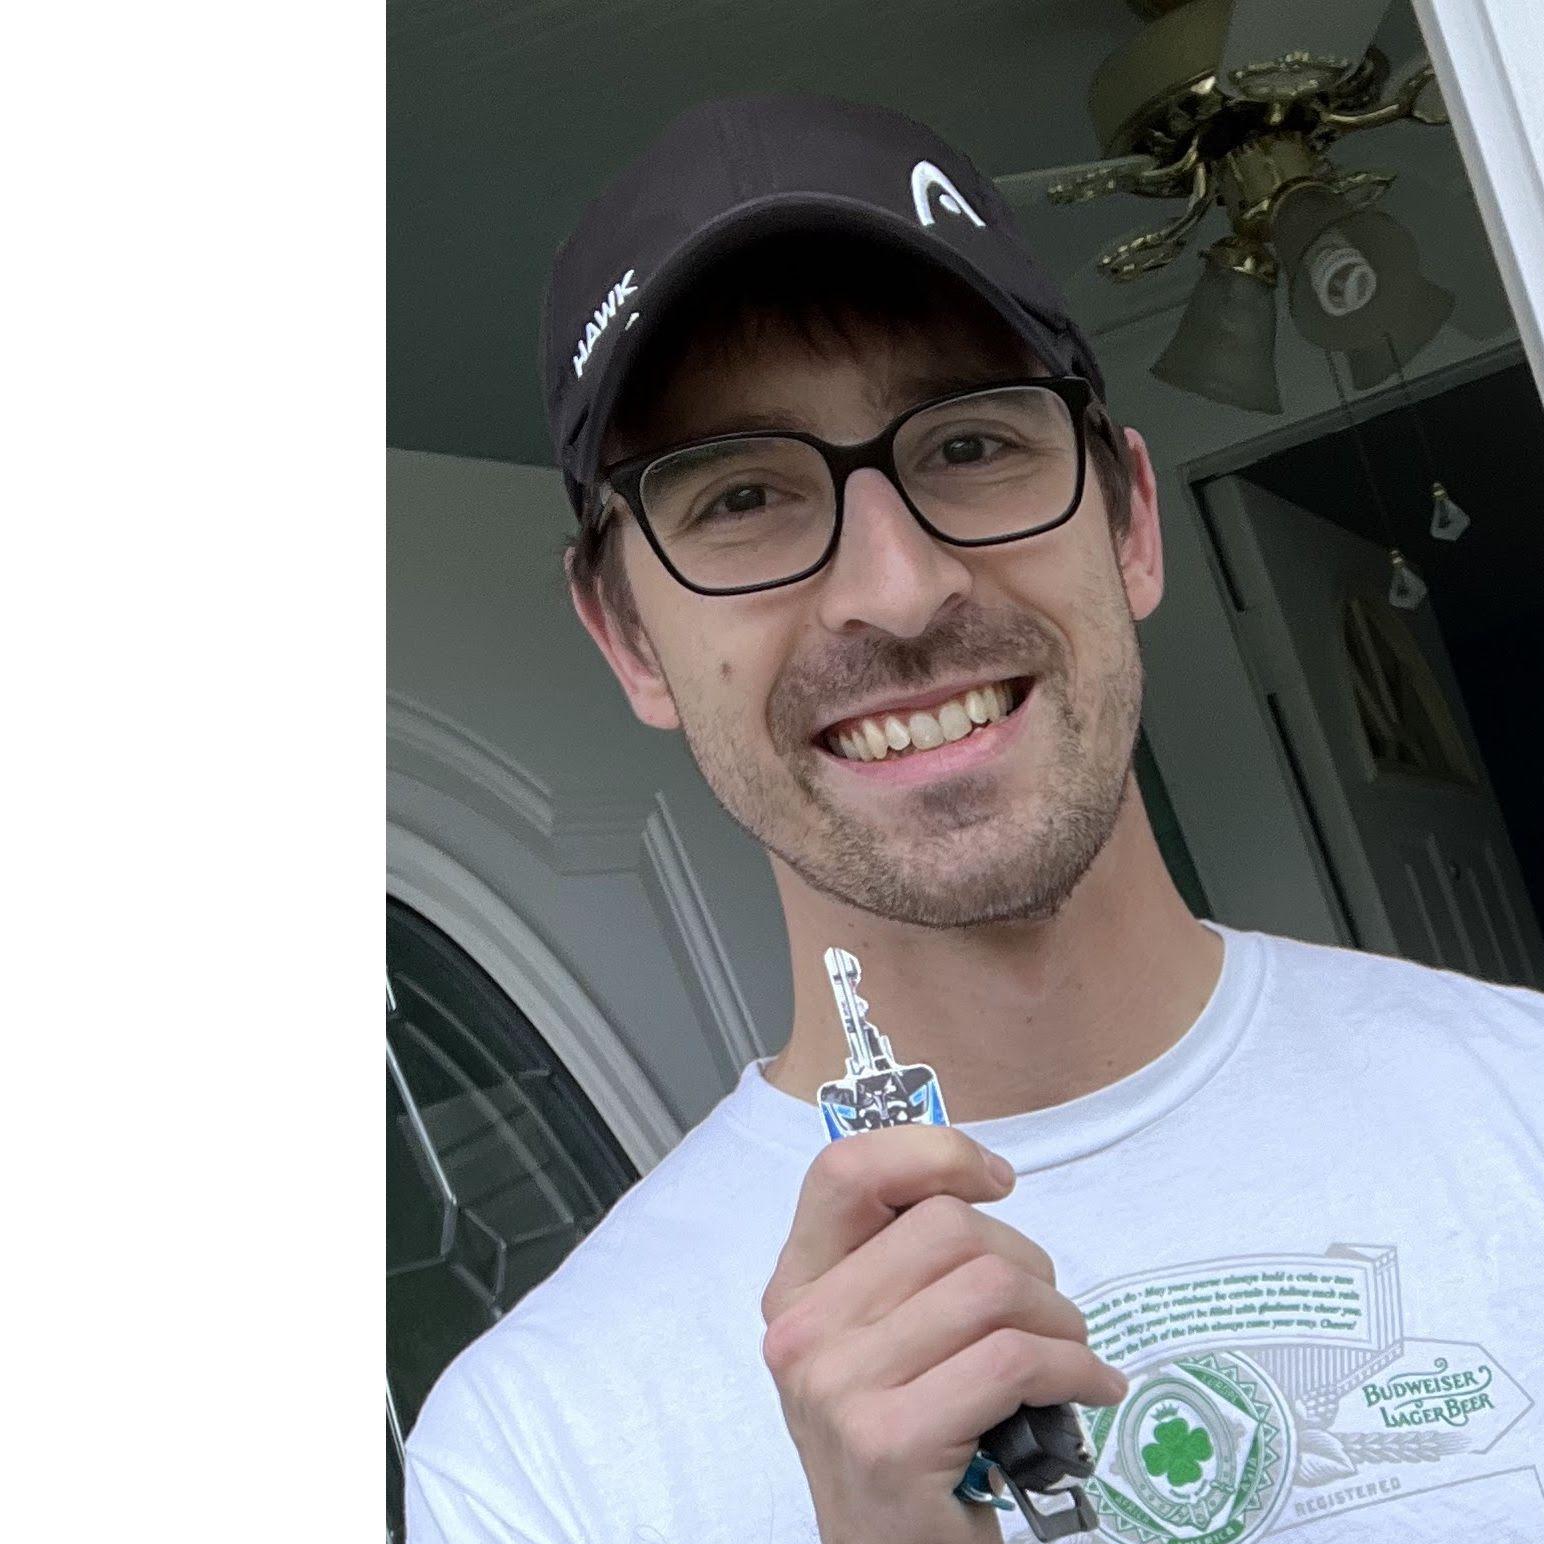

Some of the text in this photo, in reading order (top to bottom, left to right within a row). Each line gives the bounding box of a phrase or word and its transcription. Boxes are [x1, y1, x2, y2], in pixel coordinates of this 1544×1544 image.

[572, 269, 638, 380] HAWK
[1144, 1286, 1165, 1298] May
[1262, 1271, 1285, 1281] hold
[1169, 1310, 1195, 1322] heart
[1171, 1327, 1187, 1338] the
[1187, 1322, 1210, 1335] Irish
[1362, 1362, 1489, 1408] BUDWEISER
[1380, 1393, 1495, 1428] LAGER BEER
[1294, 1476, 1402, 1517] REGISTERED
